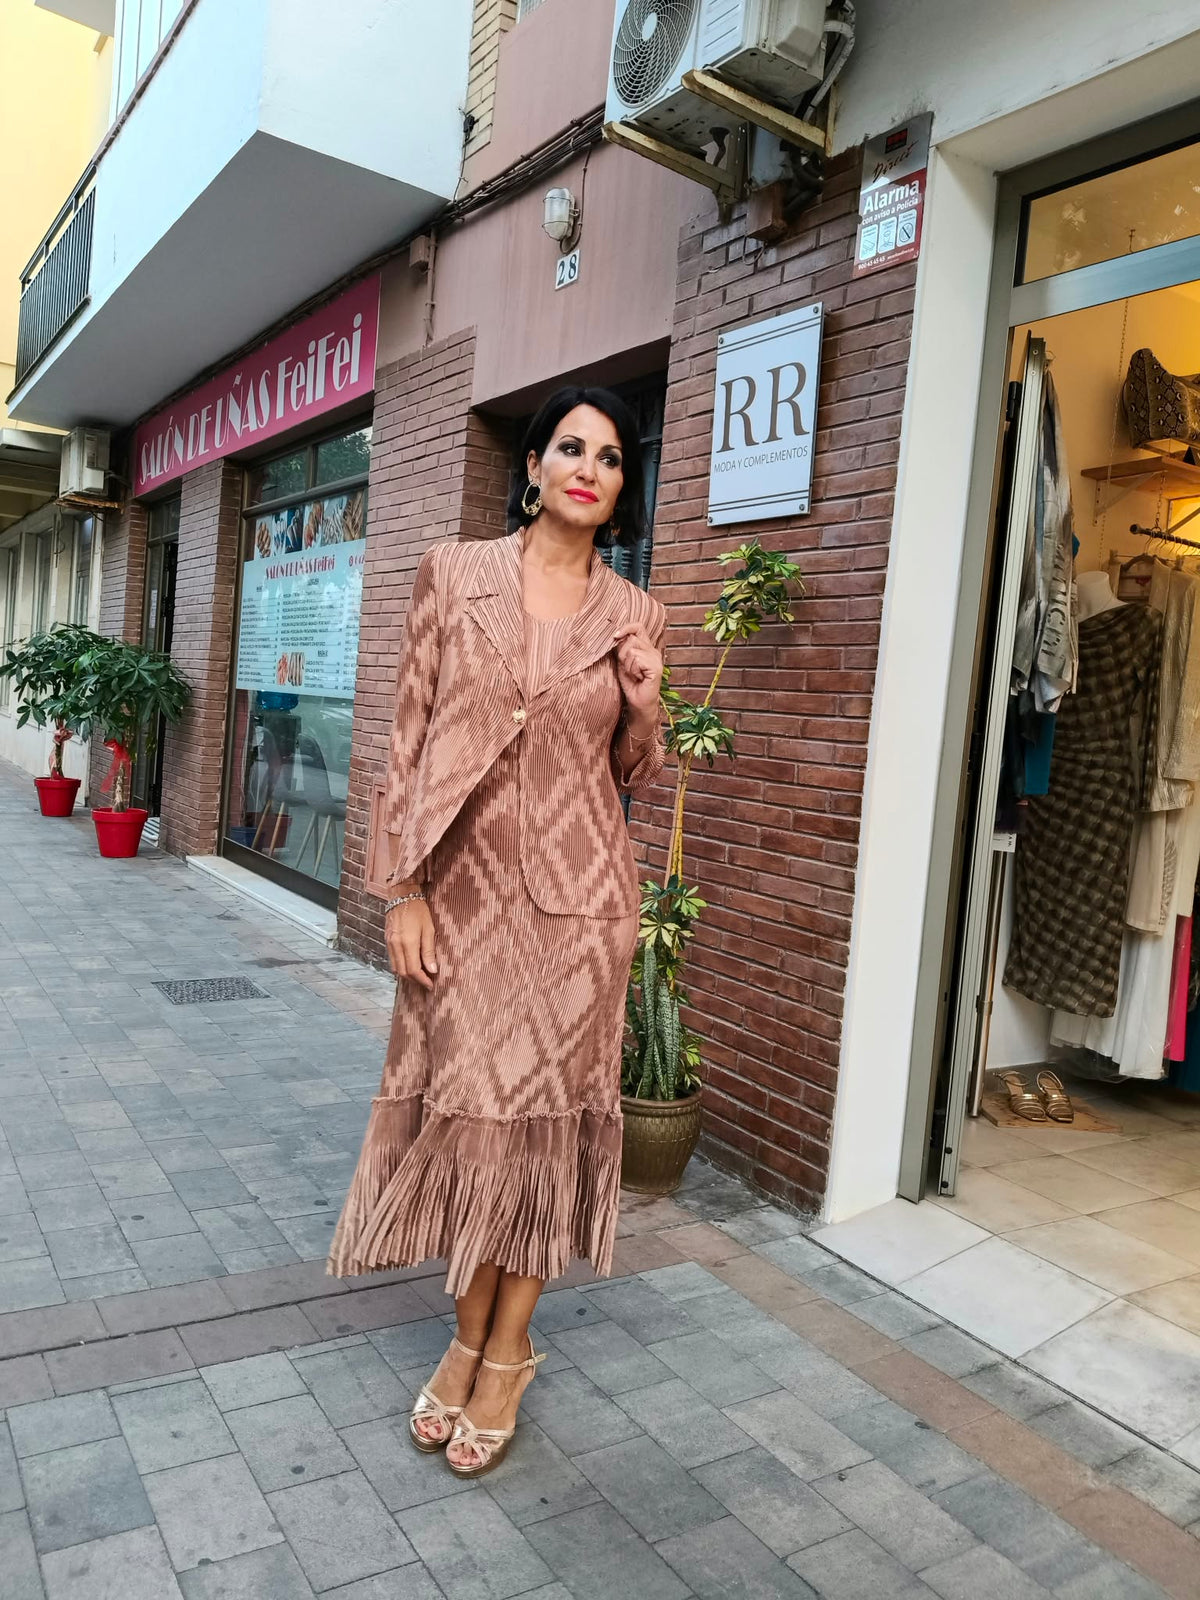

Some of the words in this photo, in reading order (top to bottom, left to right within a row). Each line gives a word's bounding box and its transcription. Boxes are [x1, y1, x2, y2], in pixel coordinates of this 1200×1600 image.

[863, 180, 919, 215] Alarma
[861, 216, 873, 226] con
[874, 209, 891, 221] aviso
[557, 254, 577, 286] 28
[139, 416, 186, 485] SALÓN
[187, 404, 212, 462] DE
[214, 372, 271, 449] UÑAS
[276, 313, 362, 419] FeiFei
[716, 362, 810, 454] RR
[714, 459, 736, 473] MODA
[737, 458, 743, 469] Y
[743, 446, 808, 468] COMPLEMENTOS
